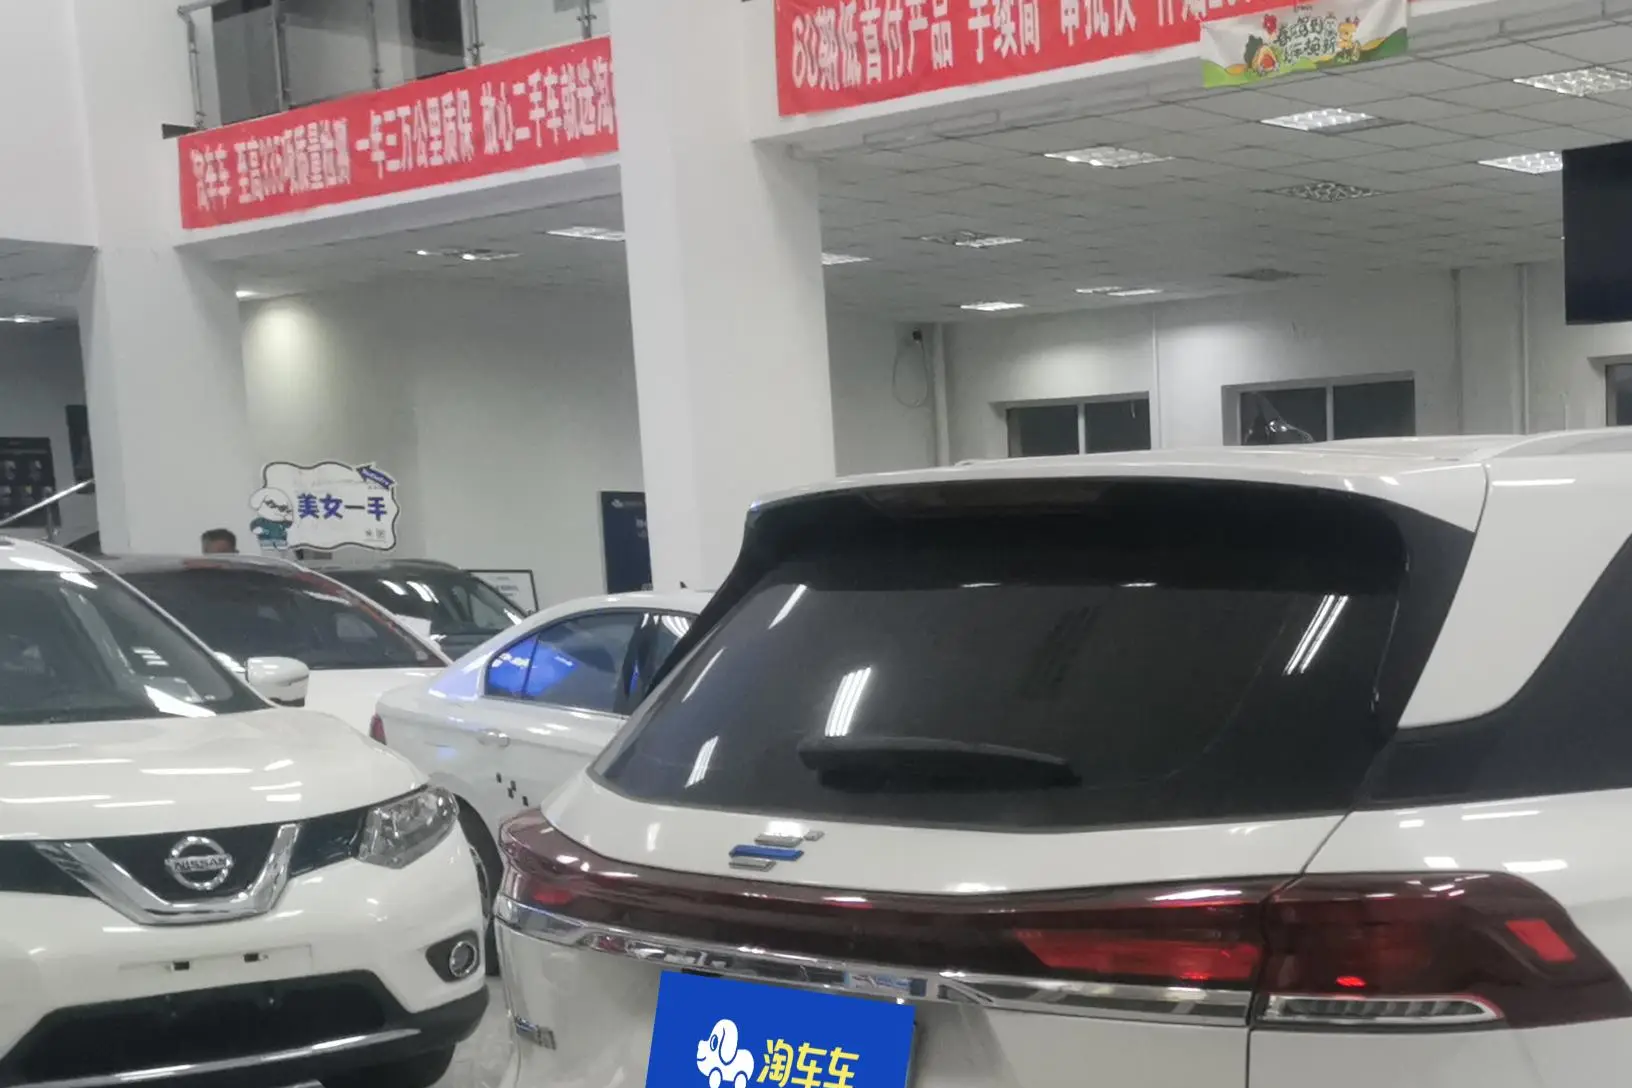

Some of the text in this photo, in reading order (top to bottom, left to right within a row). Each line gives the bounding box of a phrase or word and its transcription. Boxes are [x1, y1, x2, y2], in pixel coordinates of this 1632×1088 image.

[480, 56, 614, 155] 放心二手车就选淘
[174, 855, 226, 873] NISSAN
